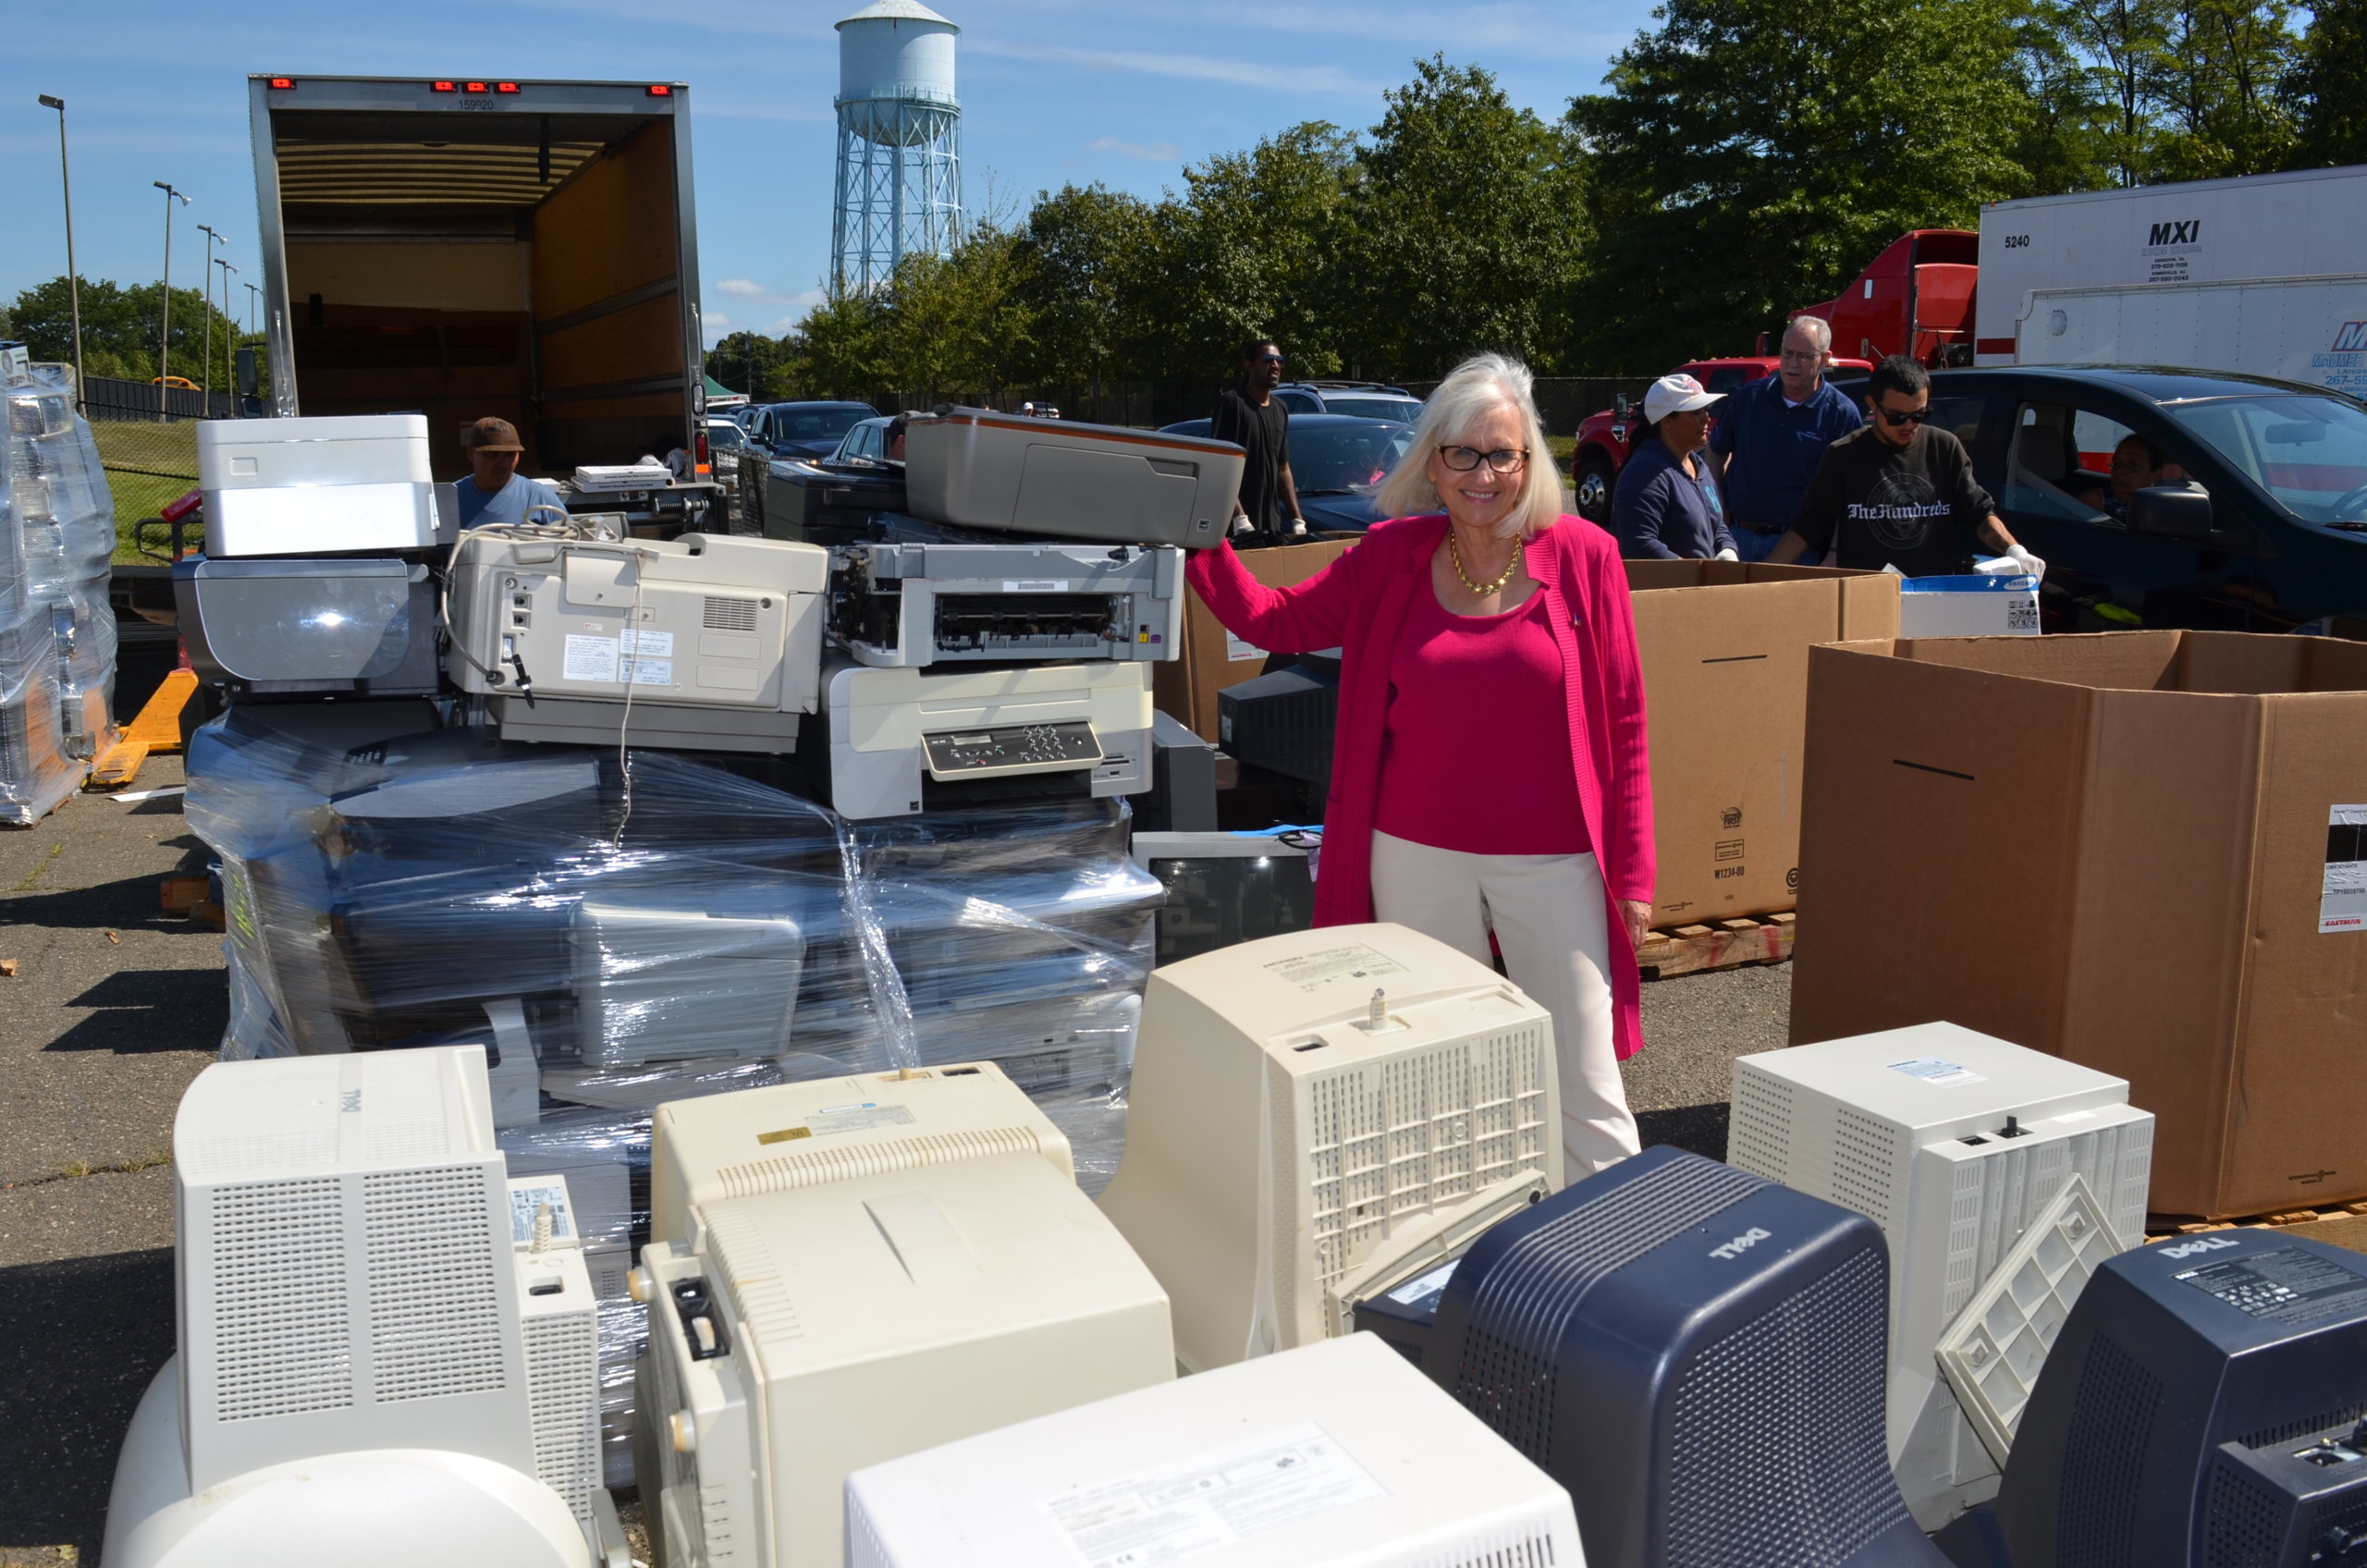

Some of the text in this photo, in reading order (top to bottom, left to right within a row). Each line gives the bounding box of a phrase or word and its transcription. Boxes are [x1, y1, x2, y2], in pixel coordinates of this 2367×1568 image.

[2005, 234, 2030, 249] 5240
[2148, 220, 2201, 246] MXI
[2312, 353, 2363, 367] MAUMEE
[1714, 866, 1745, 879] W1234-00
[1708, 1227, 1772, 1259] DELL
[2157, 1237, 2241, 1259] DELL
